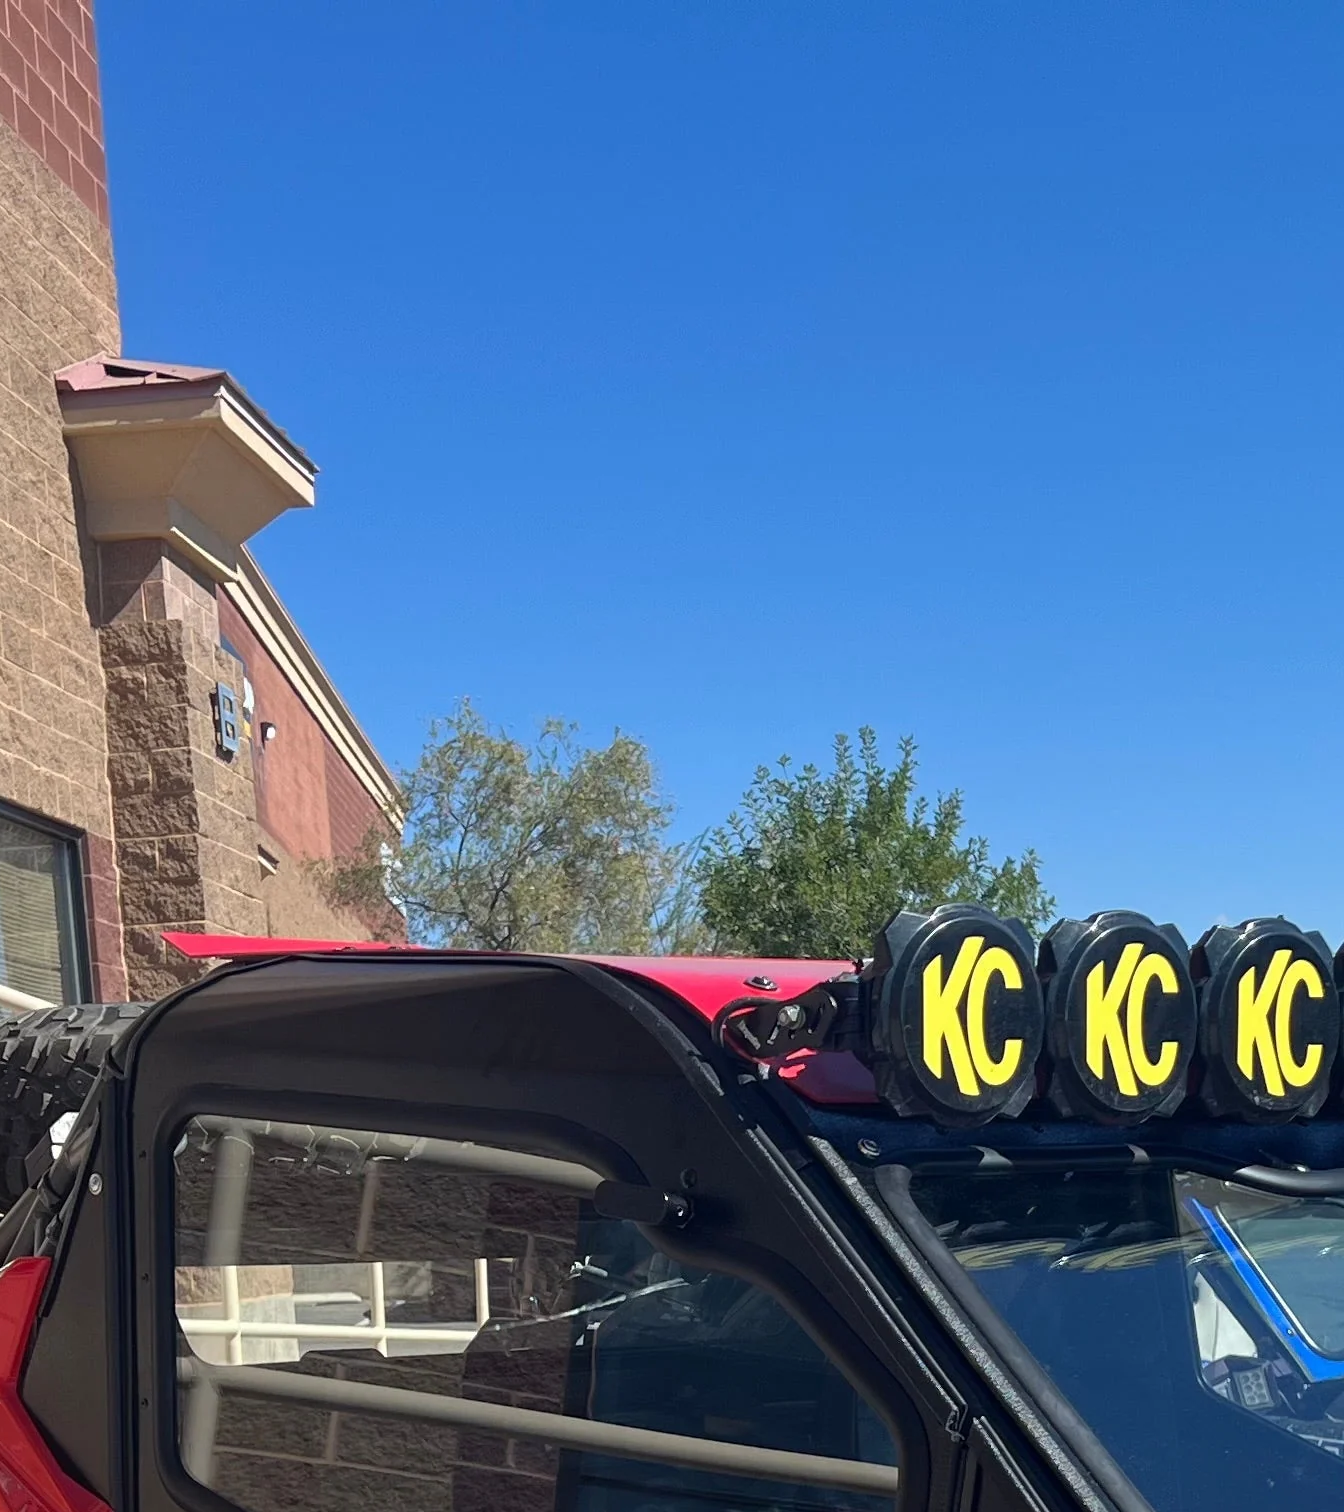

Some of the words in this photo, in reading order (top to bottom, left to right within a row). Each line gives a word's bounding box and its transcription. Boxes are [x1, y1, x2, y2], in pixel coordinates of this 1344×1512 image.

[923, 936, 1022, 1096] KC
[1086, 943, 1178, 1097] KC
[1237, 949, 1323, 1097] KC
